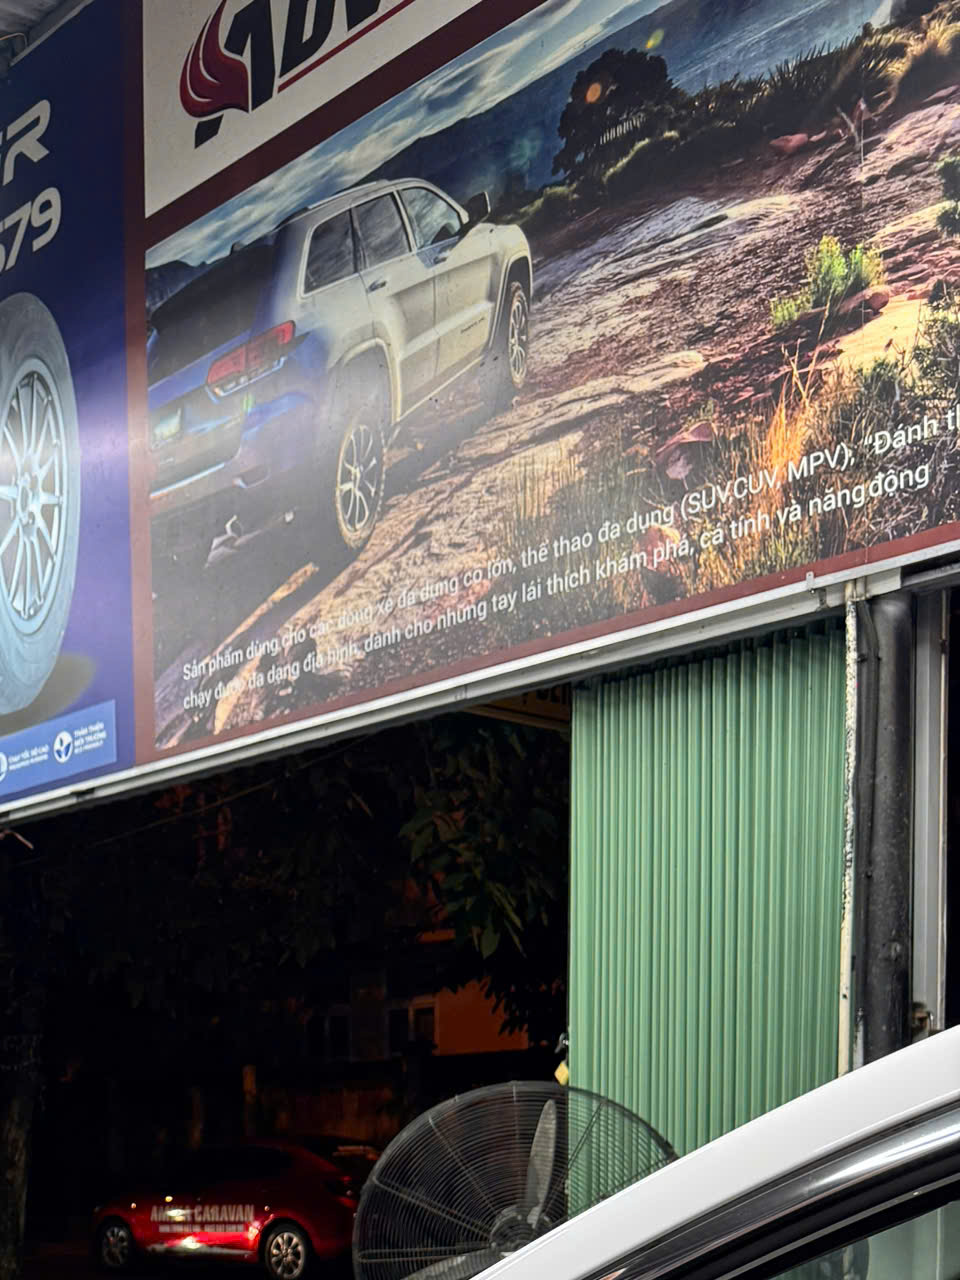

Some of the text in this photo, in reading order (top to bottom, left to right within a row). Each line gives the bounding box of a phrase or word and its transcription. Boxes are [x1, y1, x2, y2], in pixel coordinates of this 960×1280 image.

[183, 688, 212, 710] chạy
[267, 660, 301, 685] dạng
[405, 618, 433, 640] cho
[492, 591, 518, 613] tay
[522, 581, 542, 603] lái
[546, 564, 591, 597] thích
[596, 551, 648, 582] khám
[653, 534, 695, 569] phá,
[700, 521, 725, 549] cá
[730, 508, 771, 539] tính
[776, 499, 802, 526] và
[808, 485, 866, 518] năng
[868, 462, 931, 498] động
[246, 635, 279, 660] dùng
[281, 627, 306, 649] cho
[521, 538, 550, 569] thể
[553, 531, 593, 558] thao
[598, 520, 621, 543] đa
[626, 505, 675, 535] dụng
[194, 1204, 255, 1223] CARAVAN
